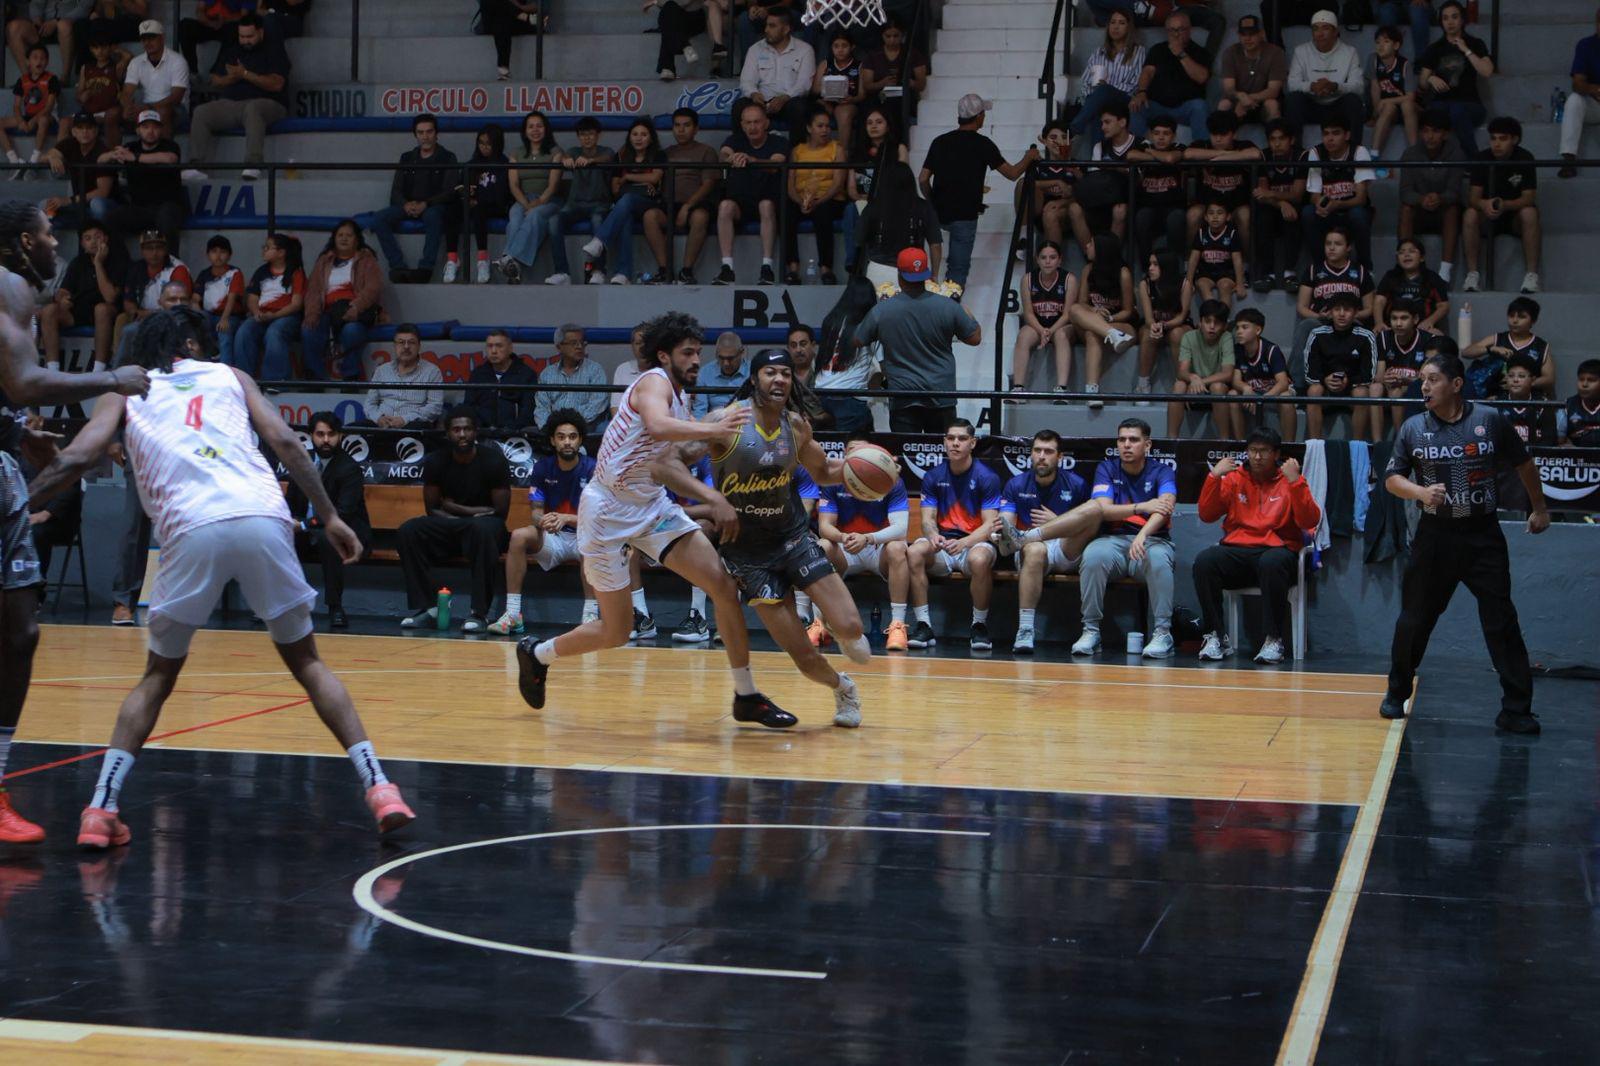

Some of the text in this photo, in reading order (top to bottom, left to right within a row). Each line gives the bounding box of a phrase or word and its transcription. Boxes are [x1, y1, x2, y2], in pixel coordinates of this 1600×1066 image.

[297, 90, 367, 117] STUDIO
[381, 86, 643, 113] CIRCULO LLANTERO
[186, 185, 255, 217] LIA
[1533, 457, 1577, 467] ENERAL
[1539, 466, 1600, 483] SALUD
[745, 504, 784, 517] Coppel
